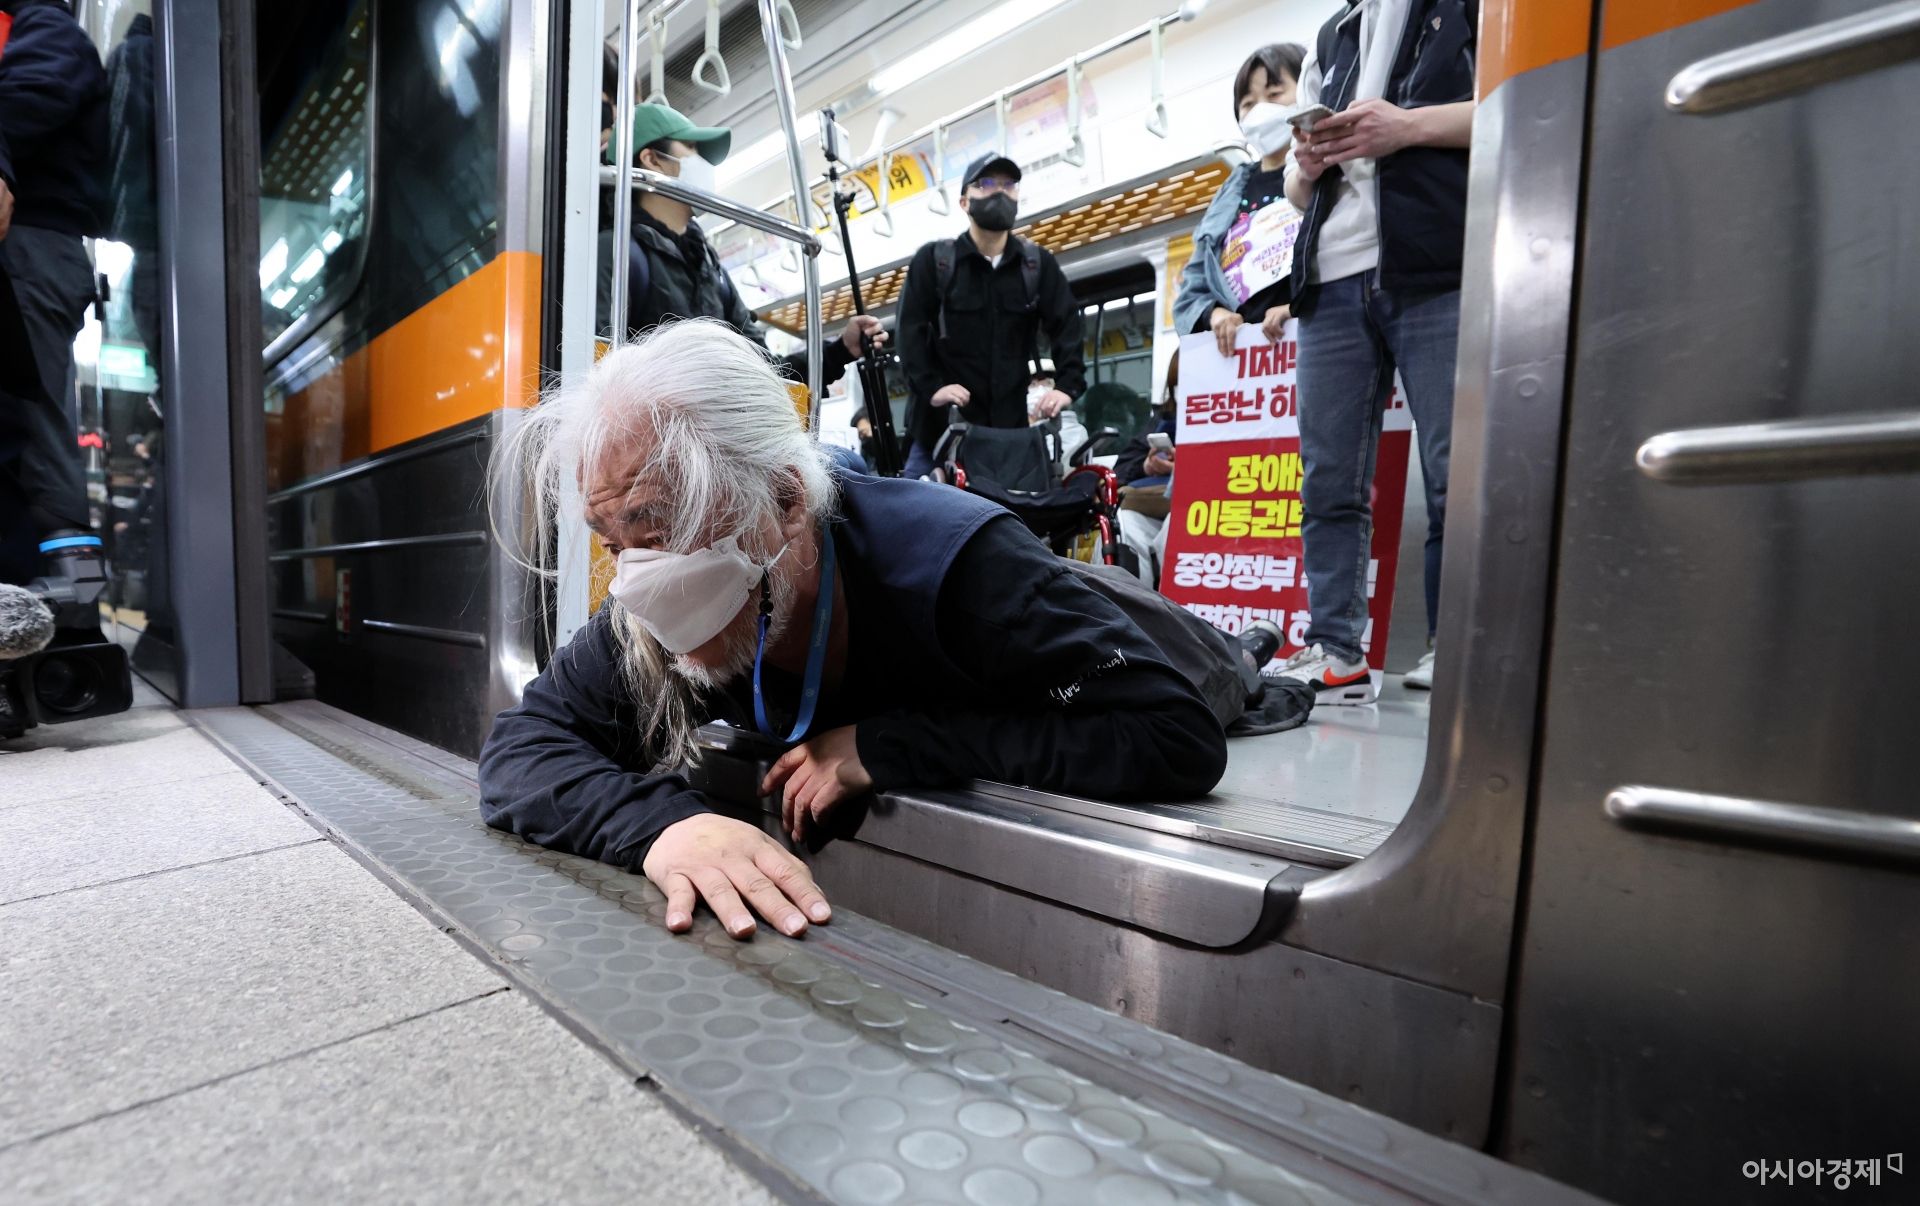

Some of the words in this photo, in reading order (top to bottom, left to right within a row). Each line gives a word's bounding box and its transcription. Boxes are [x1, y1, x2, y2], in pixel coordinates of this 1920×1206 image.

[1185, 387, 1265, 426] 돈장난
[1186, 499, 1304, 538] 이동권
[1174, 553, 1296, 592] 중앙정부
